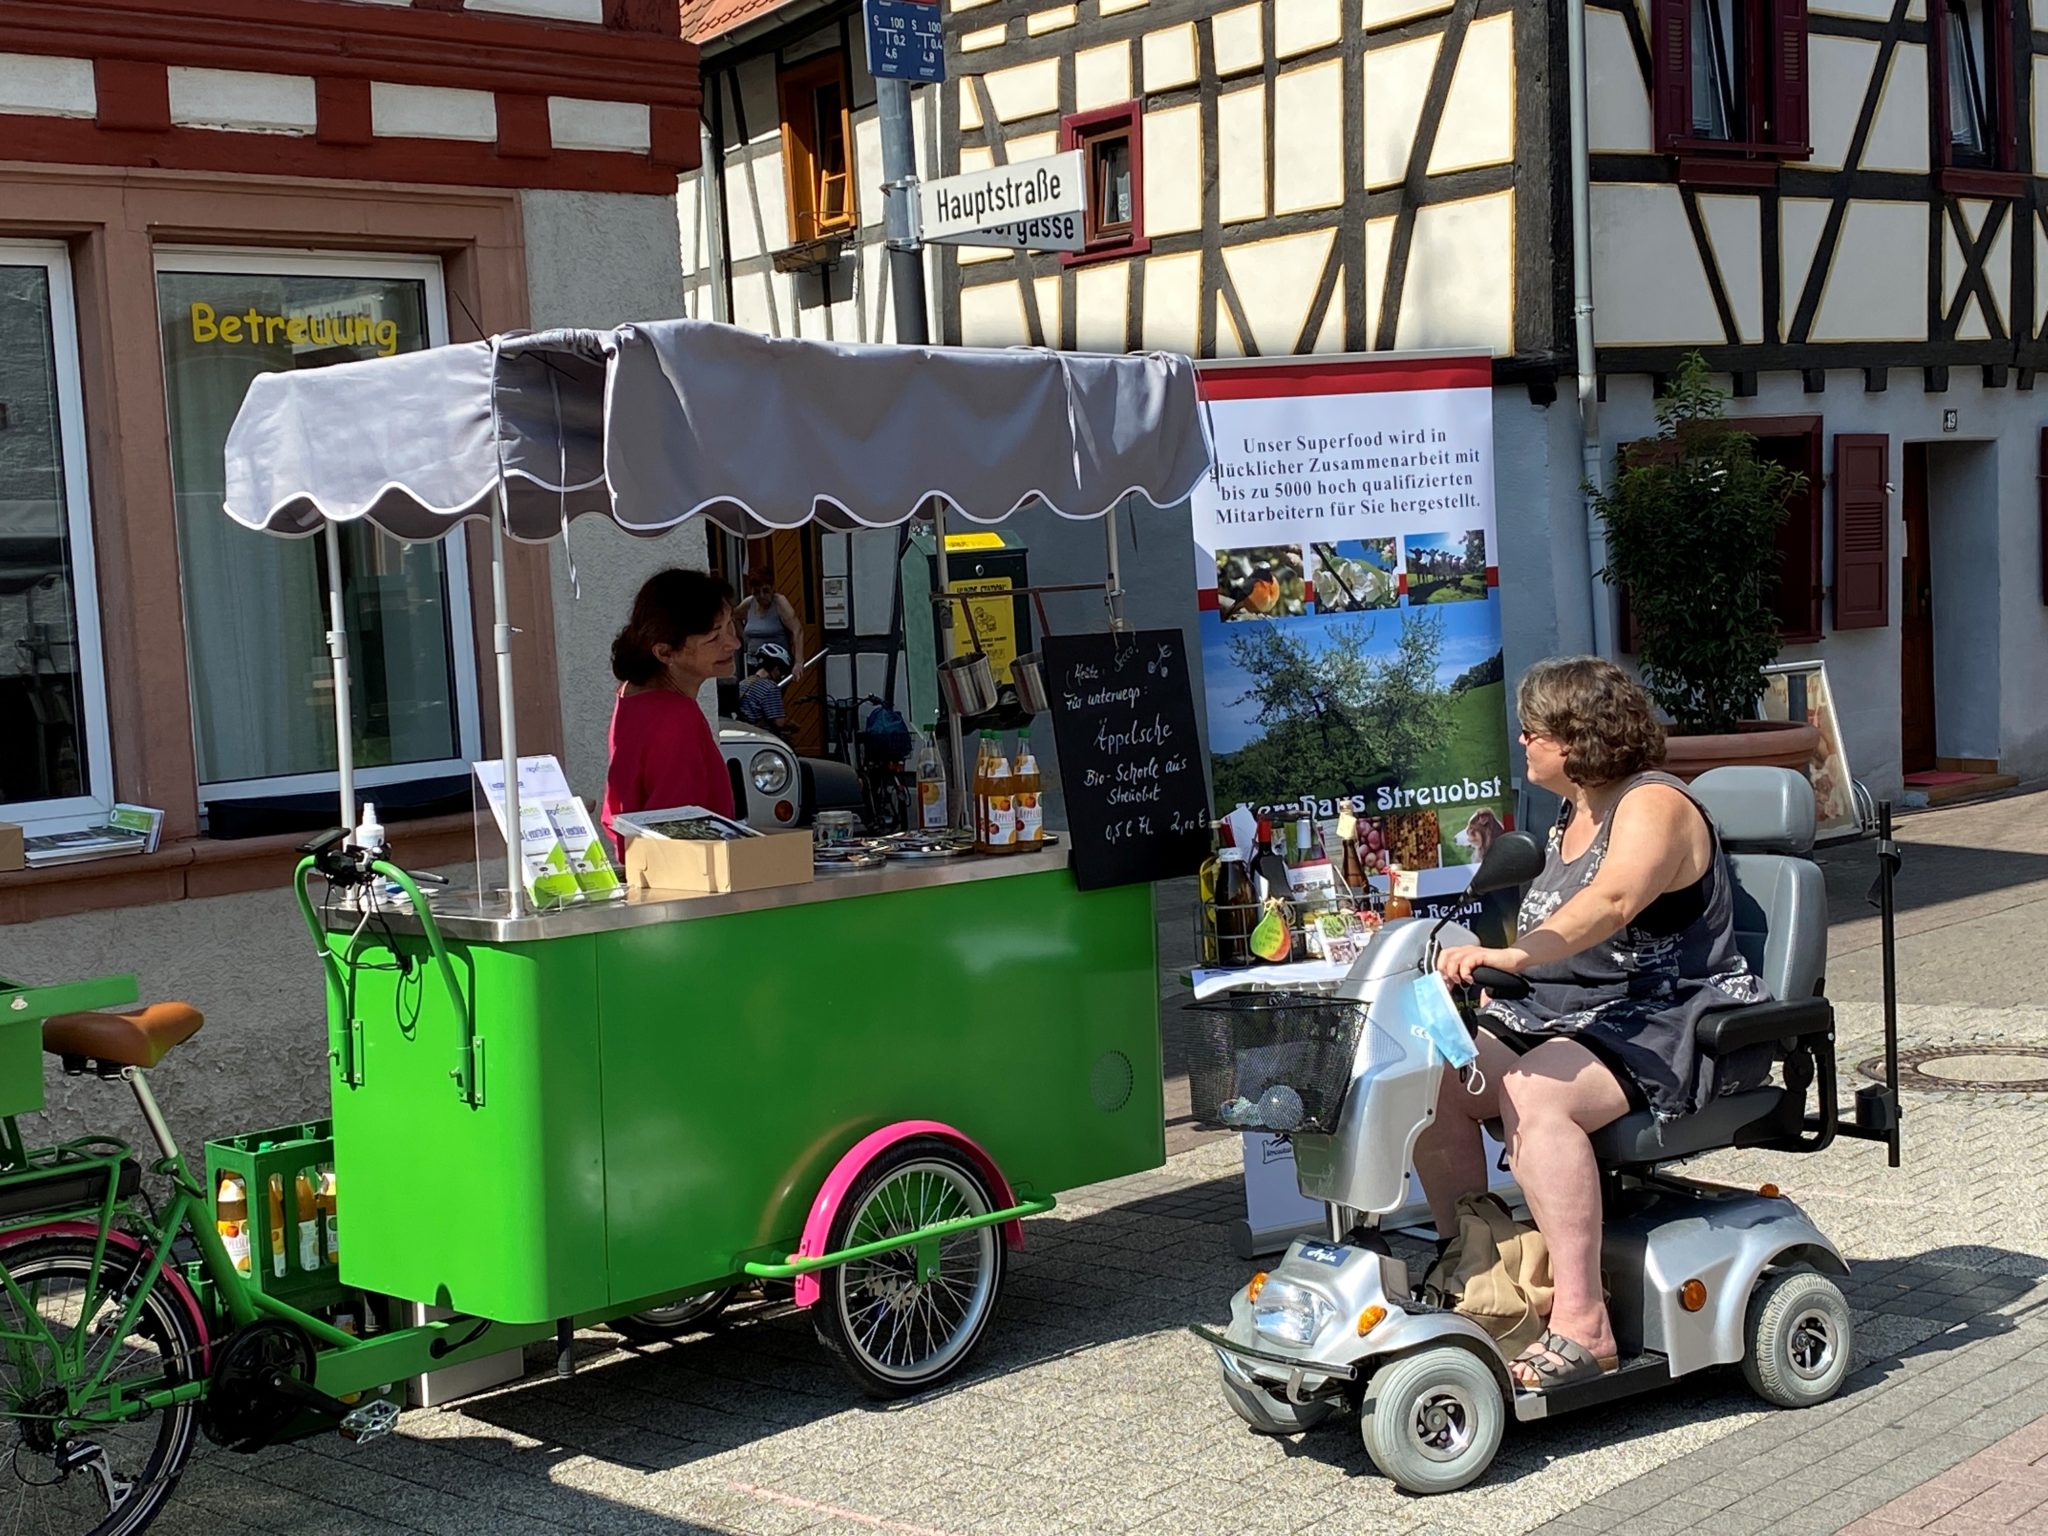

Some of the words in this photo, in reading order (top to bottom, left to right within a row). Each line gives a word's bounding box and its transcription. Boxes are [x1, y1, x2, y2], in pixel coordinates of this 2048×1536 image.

[873, 14, 880, 26] S
[890, 16, 905, 29] 100
[911, 19, 917, 31] S
[927, 21, 941, 33] 100
[936, 168, 1061, 224] Hauptstraße
[191, 302, 397, 356] Betreuung
[1243, 437, 1292, 454] Unser
[1296, 431, 1383, 453] Superfood
[1389, 429, 1426, 445] wird
[1431, 428, 1447, 444] in
[1209, 460, 1304, 482] glücklicher
[1309, 450, 1451, 474] Zusammenarbeit
[1455, 448, 1481, 464] mit
[1221, 486, 1246, 501] bis
[1251, 487, 1270, 500] zu
[1274, 480, 1312, 498] 5000
[1317, 477, 1357, 496] hoch
[1362, 473, 1474, 496] qualifizierten
[1215, 506, 1325, 525] Mitarbeitern
[1330, 501, 1357, 517] für
[1361, 499, 1386, 514] Sie
[1390, 493, 1481, 515] hergestellt.
[1093, 713, 1173, 755] Äppelsche
[1376, 775, 1502, 812] Streuobst
